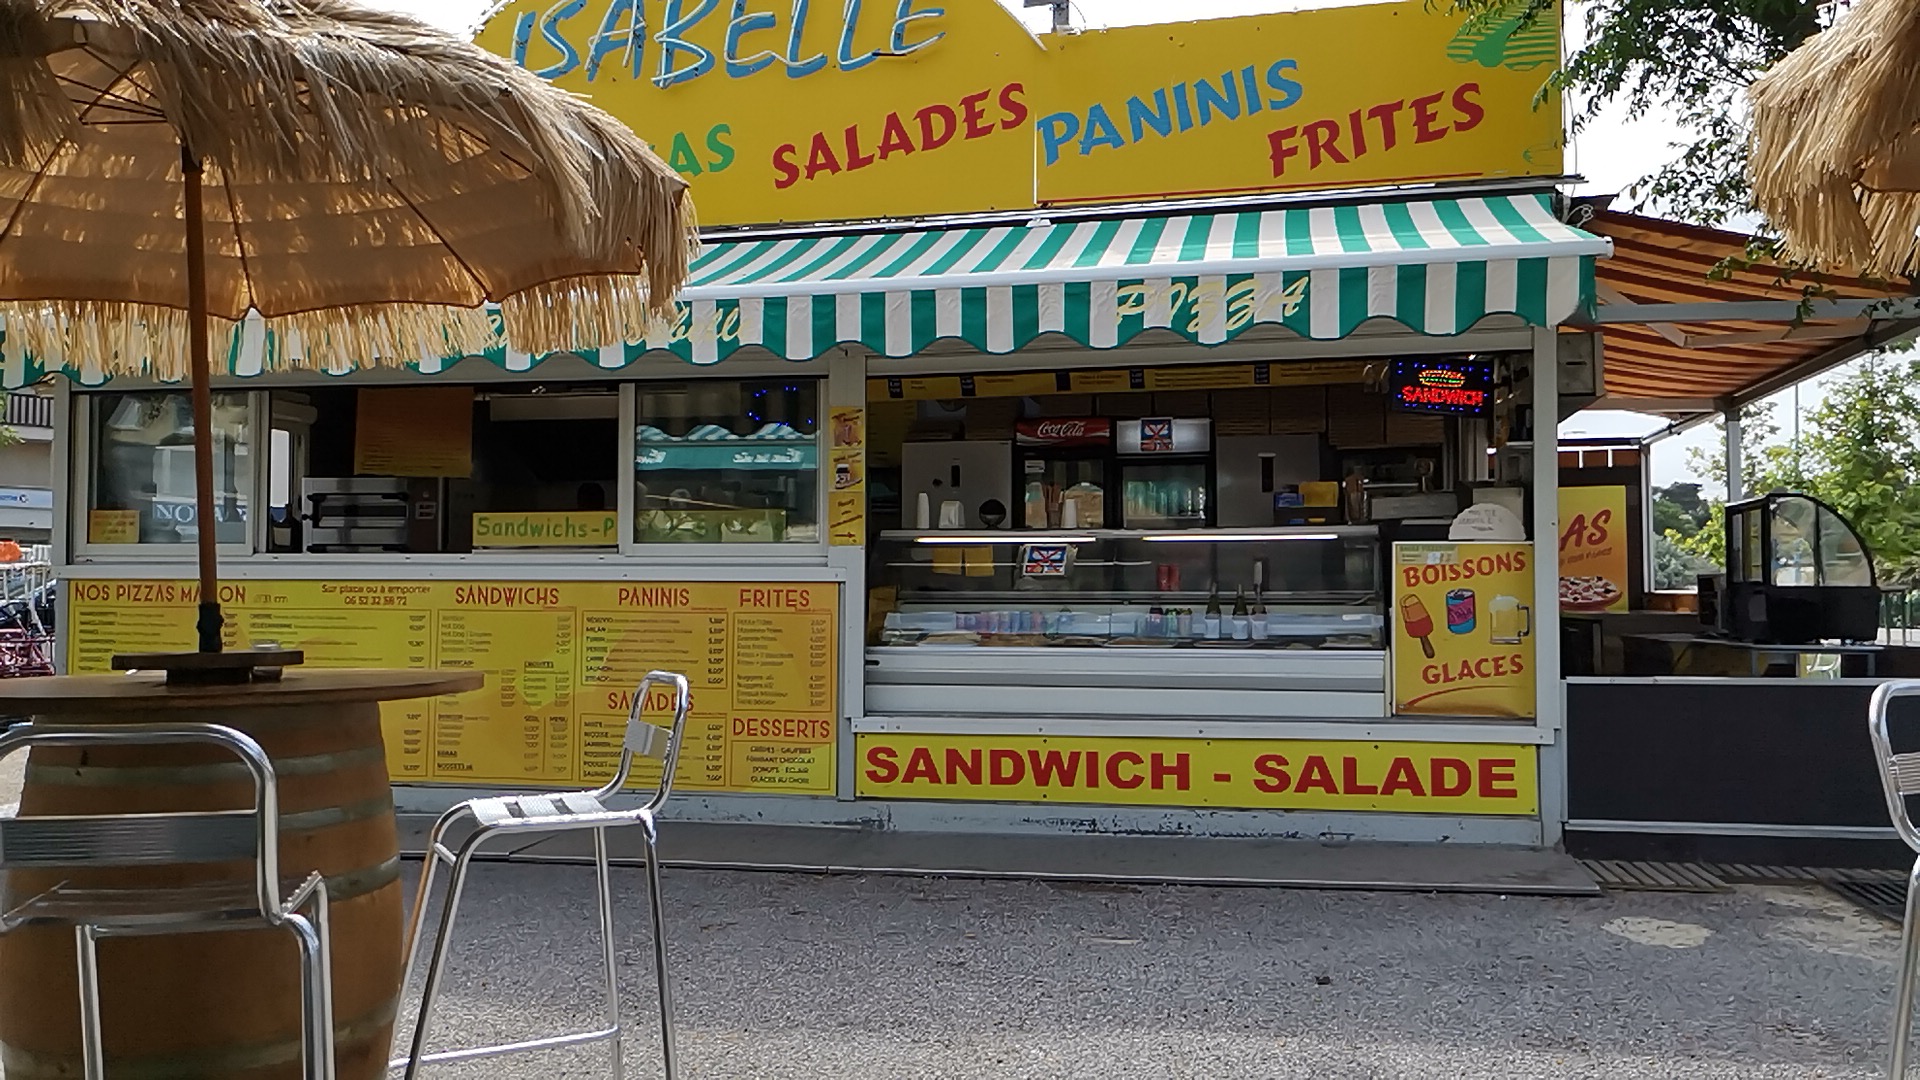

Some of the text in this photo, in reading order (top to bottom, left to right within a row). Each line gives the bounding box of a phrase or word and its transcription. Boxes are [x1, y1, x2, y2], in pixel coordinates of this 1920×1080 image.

[511, 0, 946, 89] ISABELLE
[1038, 59, 1302, 167] PANINIS
[772, 82, 1027, 189] SALADES
[1268, 83, 1484, 178] FRITES
[1116, 276, 1308, 333] PIZZA
[1402, 385, 1483, 406] SANDWICH
[1402, 551, 1526, 588] BOISSONS
[75, 583, 246, 604] NOS PIZZAS MAON
[455, 585, 560, 607] SANDWICHS
[618, 587, 690, 608] PANINIS
[739, 589, 810, 608] FRITES
[1421, 654, 1524, 684] GLACES
[733, 718, 830, 738] DESSERTS
[864, 746, 1191, 791] SANDWICH
[1252, 752, 1518, 799] SALADE
